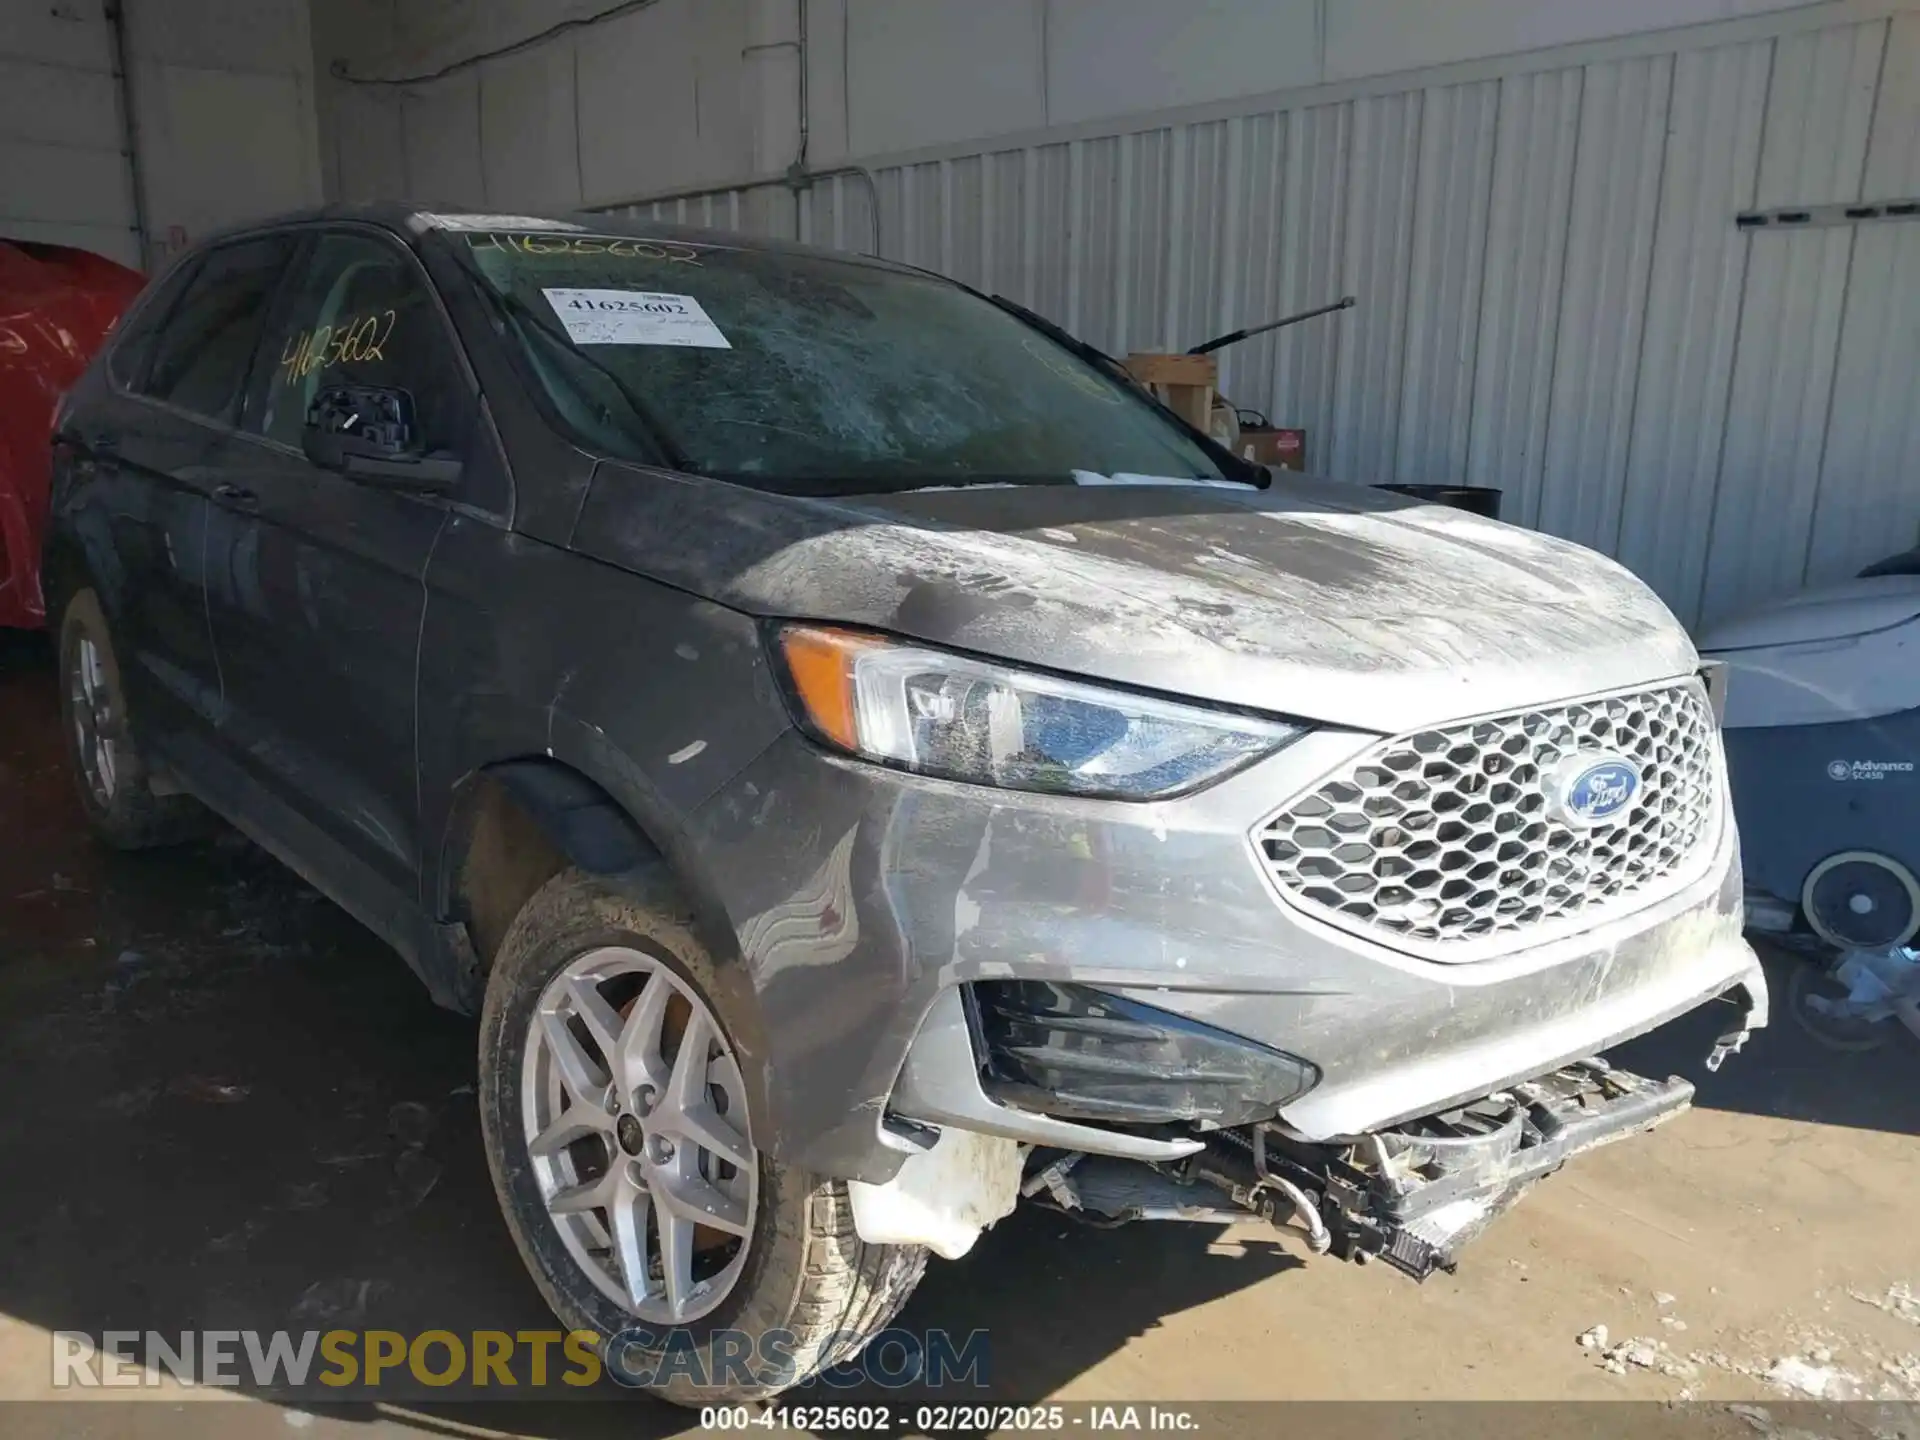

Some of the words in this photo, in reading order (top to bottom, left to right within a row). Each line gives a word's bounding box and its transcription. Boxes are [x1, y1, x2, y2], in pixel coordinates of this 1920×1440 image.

[464, 233, 704, 268] 41625602
[567, 299, 689, 315] 41625602
[281, 309, 396, 386] 41625602
[1852, 760, 1914, 771] Advance
